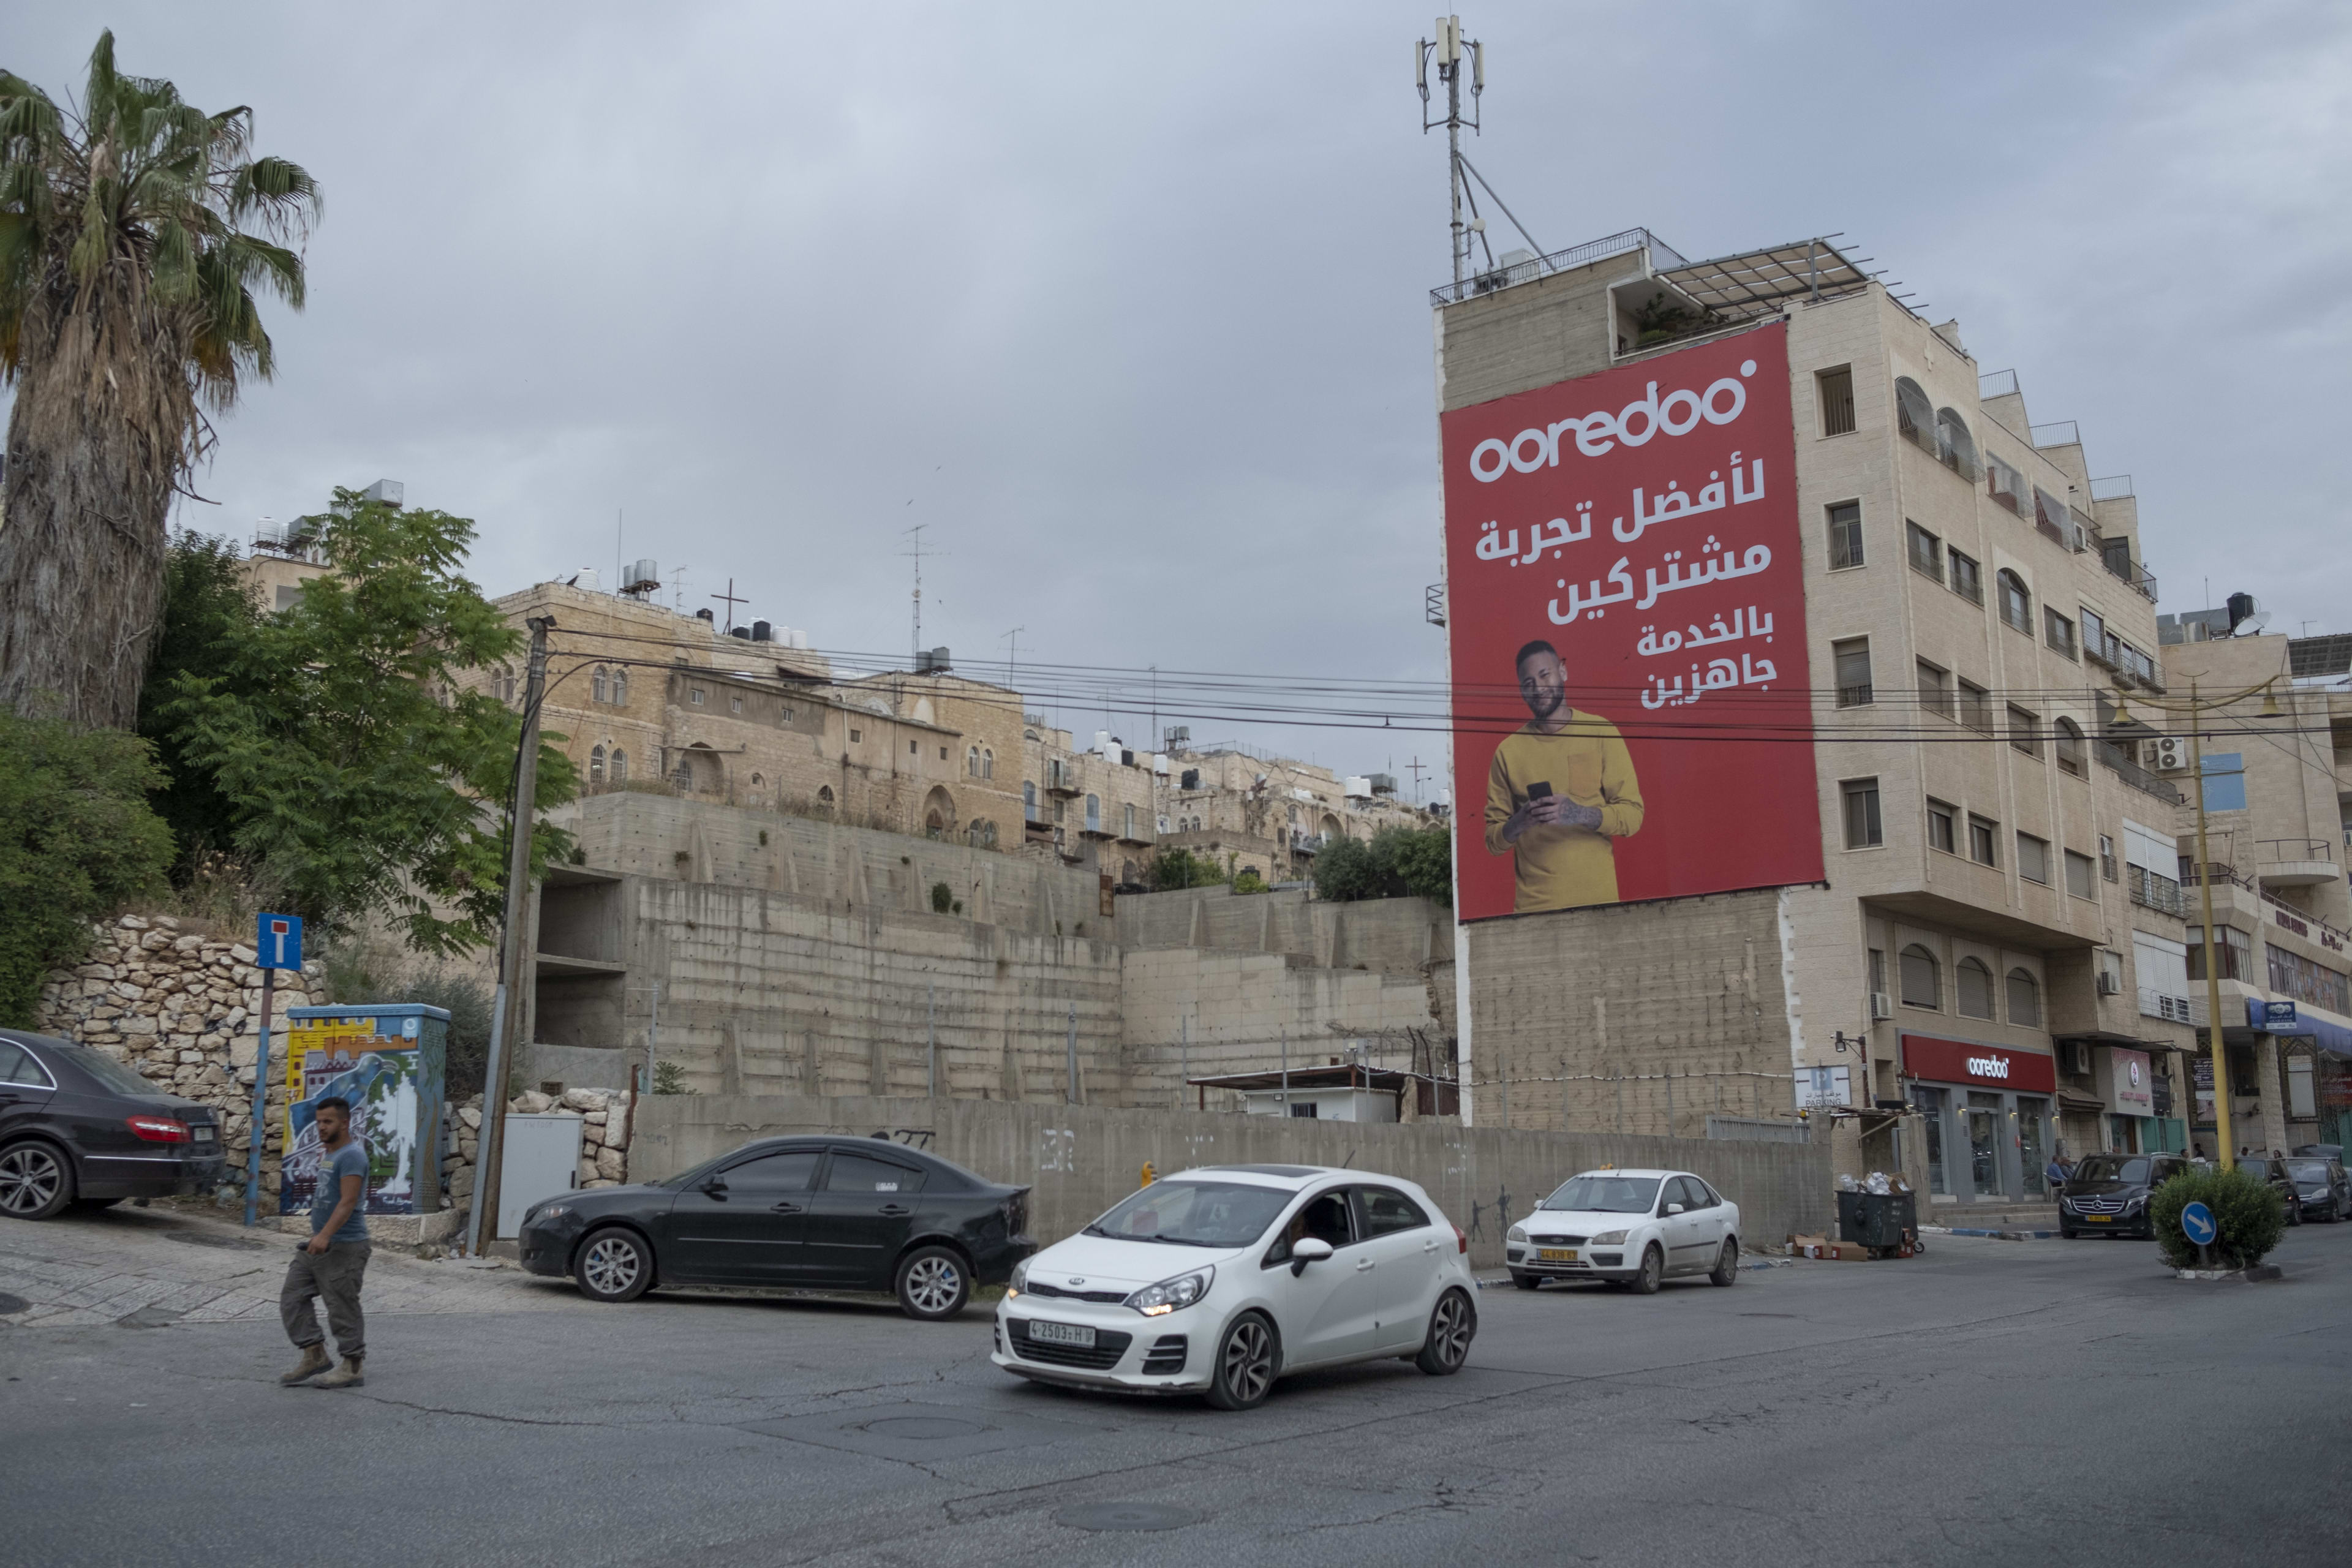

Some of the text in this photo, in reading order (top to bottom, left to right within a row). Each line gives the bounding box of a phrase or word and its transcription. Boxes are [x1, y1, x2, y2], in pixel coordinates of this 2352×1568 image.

[1470, 359, 1757, 483] ooredoo
[1476, 451, 1765, 567] لأفضل تجربة
[1548, 535, 1771, 625] مشتركين
[1637, 606, 1773, 655] بالخدمة
[1642, 654, 1777, 709] جاهزين
[1967, 1055, 2010, 1079] ooredoo
[1806, 1098, 1842, 1107] PARKING
